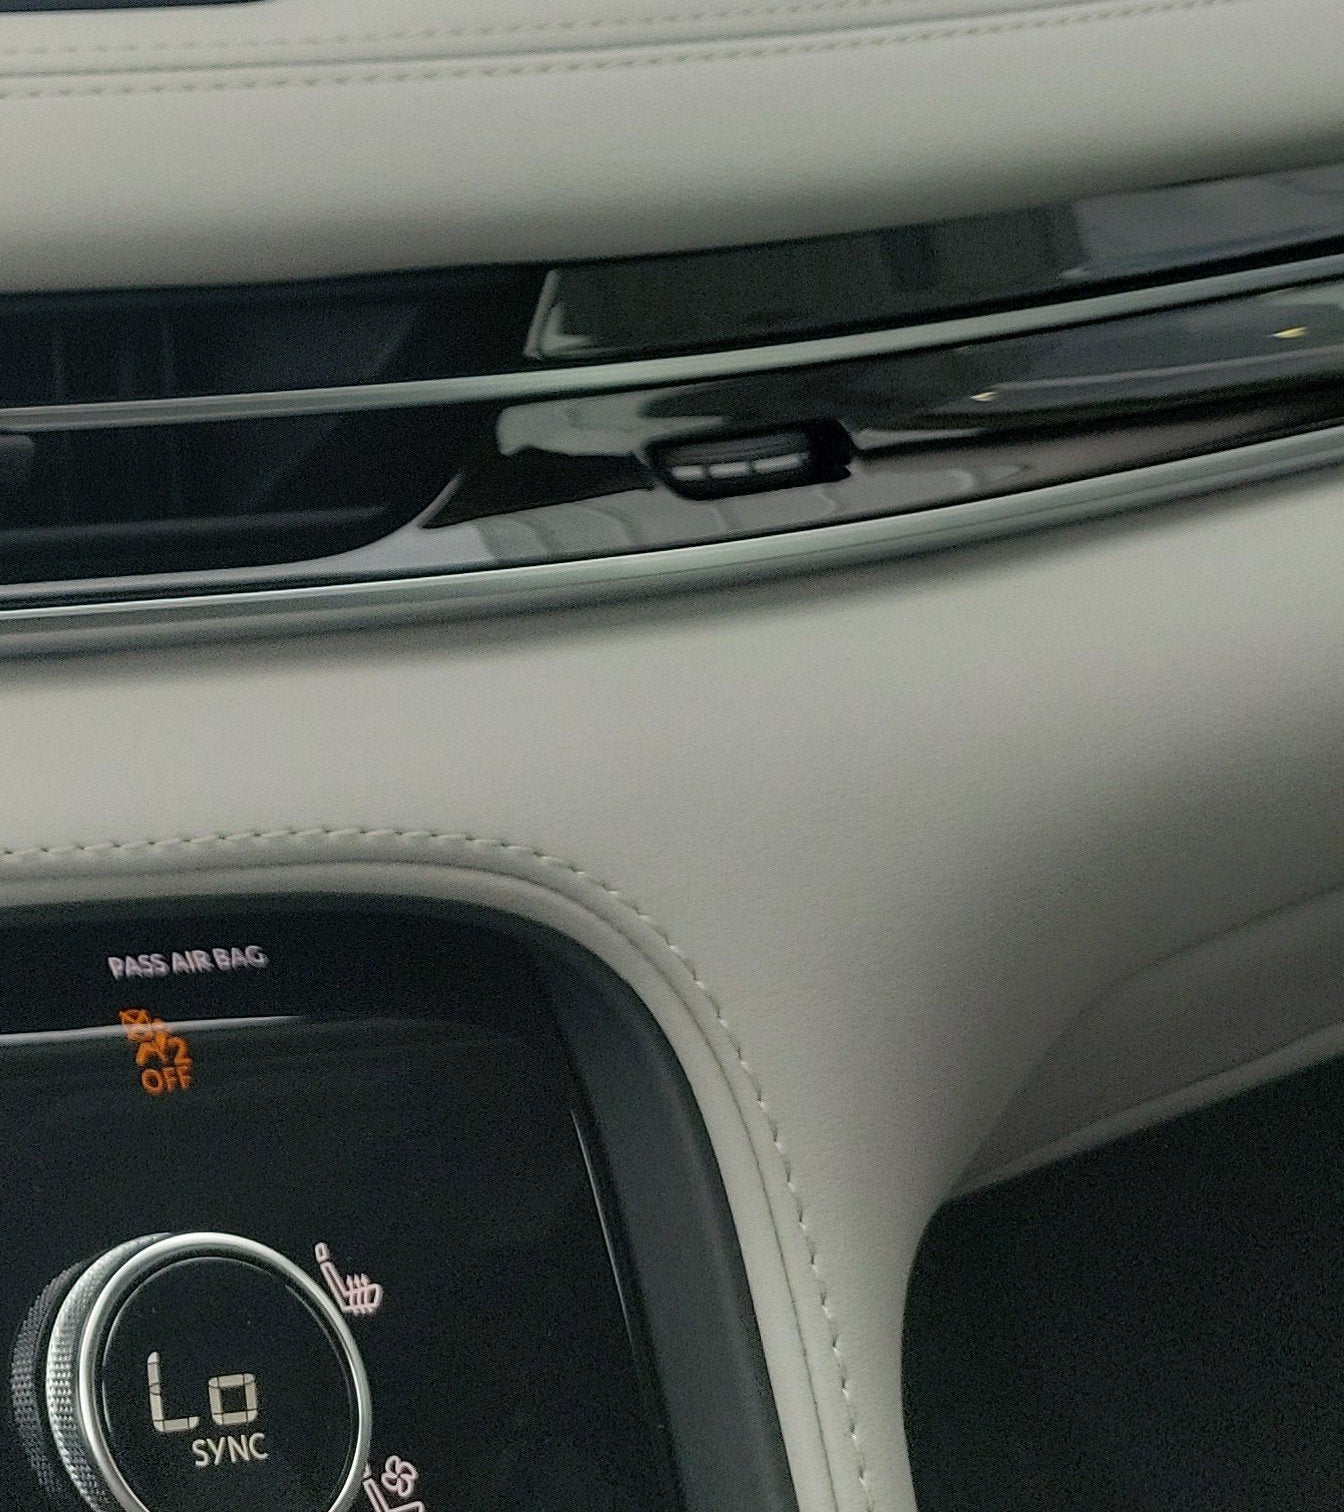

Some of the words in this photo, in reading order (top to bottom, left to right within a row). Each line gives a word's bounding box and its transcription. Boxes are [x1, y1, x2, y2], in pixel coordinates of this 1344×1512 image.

[108, 953, 170, 979] PASS
[171, 950, 213, 973] AIR
[212, 945, 269, 970] BAG
[141, 1067, 191, 1095] OFF
[147, 1351, 257, 1432] Lo
[192, 1433, 268, 1467] SYNC
